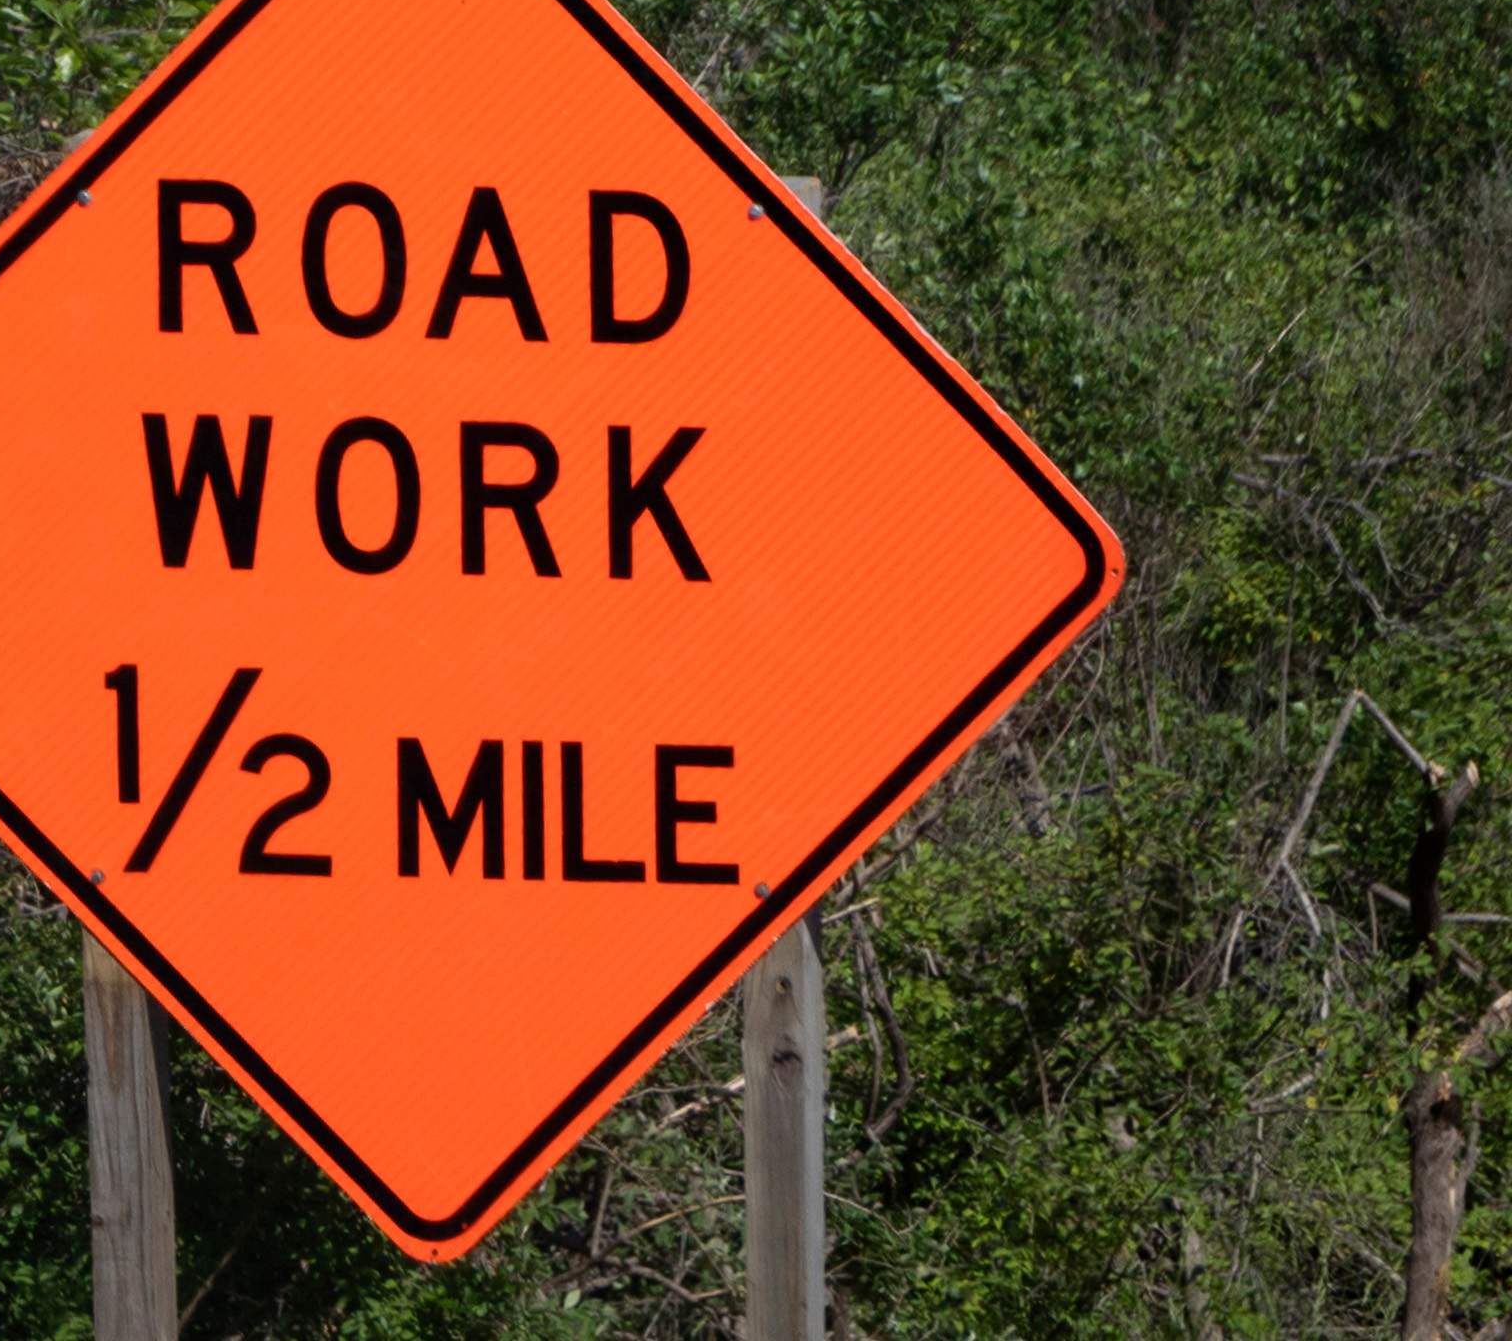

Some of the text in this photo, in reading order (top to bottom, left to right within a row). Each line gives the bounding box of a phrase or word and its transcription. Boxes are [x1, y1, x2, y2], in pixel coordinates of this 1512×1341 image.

[158, 179, 690, 344] ROAD
[142, 413, 711, 582] WORK
[105, 664, 740, 885] 1/2 MILE
